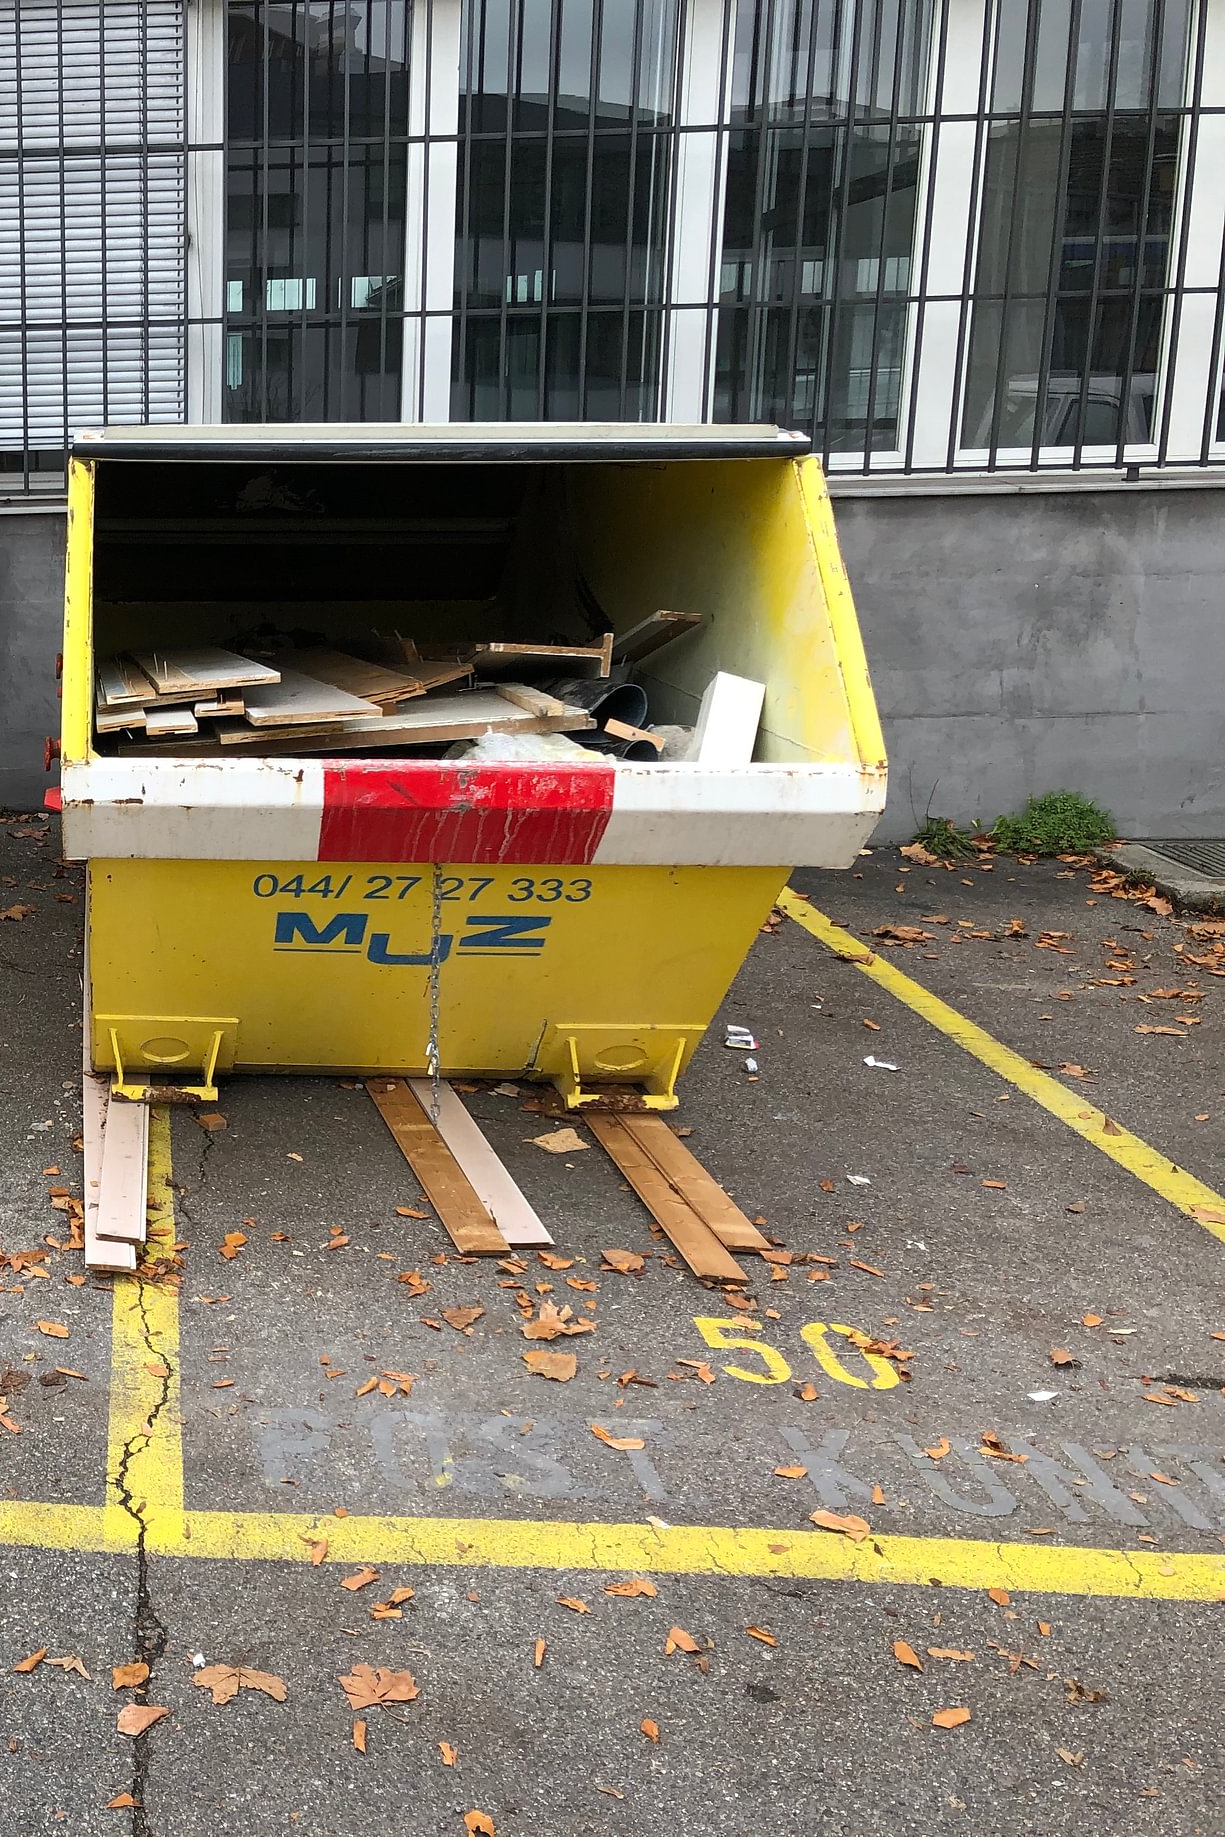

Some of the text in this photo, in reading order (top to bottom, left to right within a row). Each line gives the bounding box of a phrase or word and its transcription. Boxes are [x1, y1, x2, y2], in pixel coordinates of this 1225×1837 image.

[253, 873, 593, 903] 044/ 27 27 333
[274, 911, 553, 966] MUZ
[692, 1316, 901, 1390] 50
